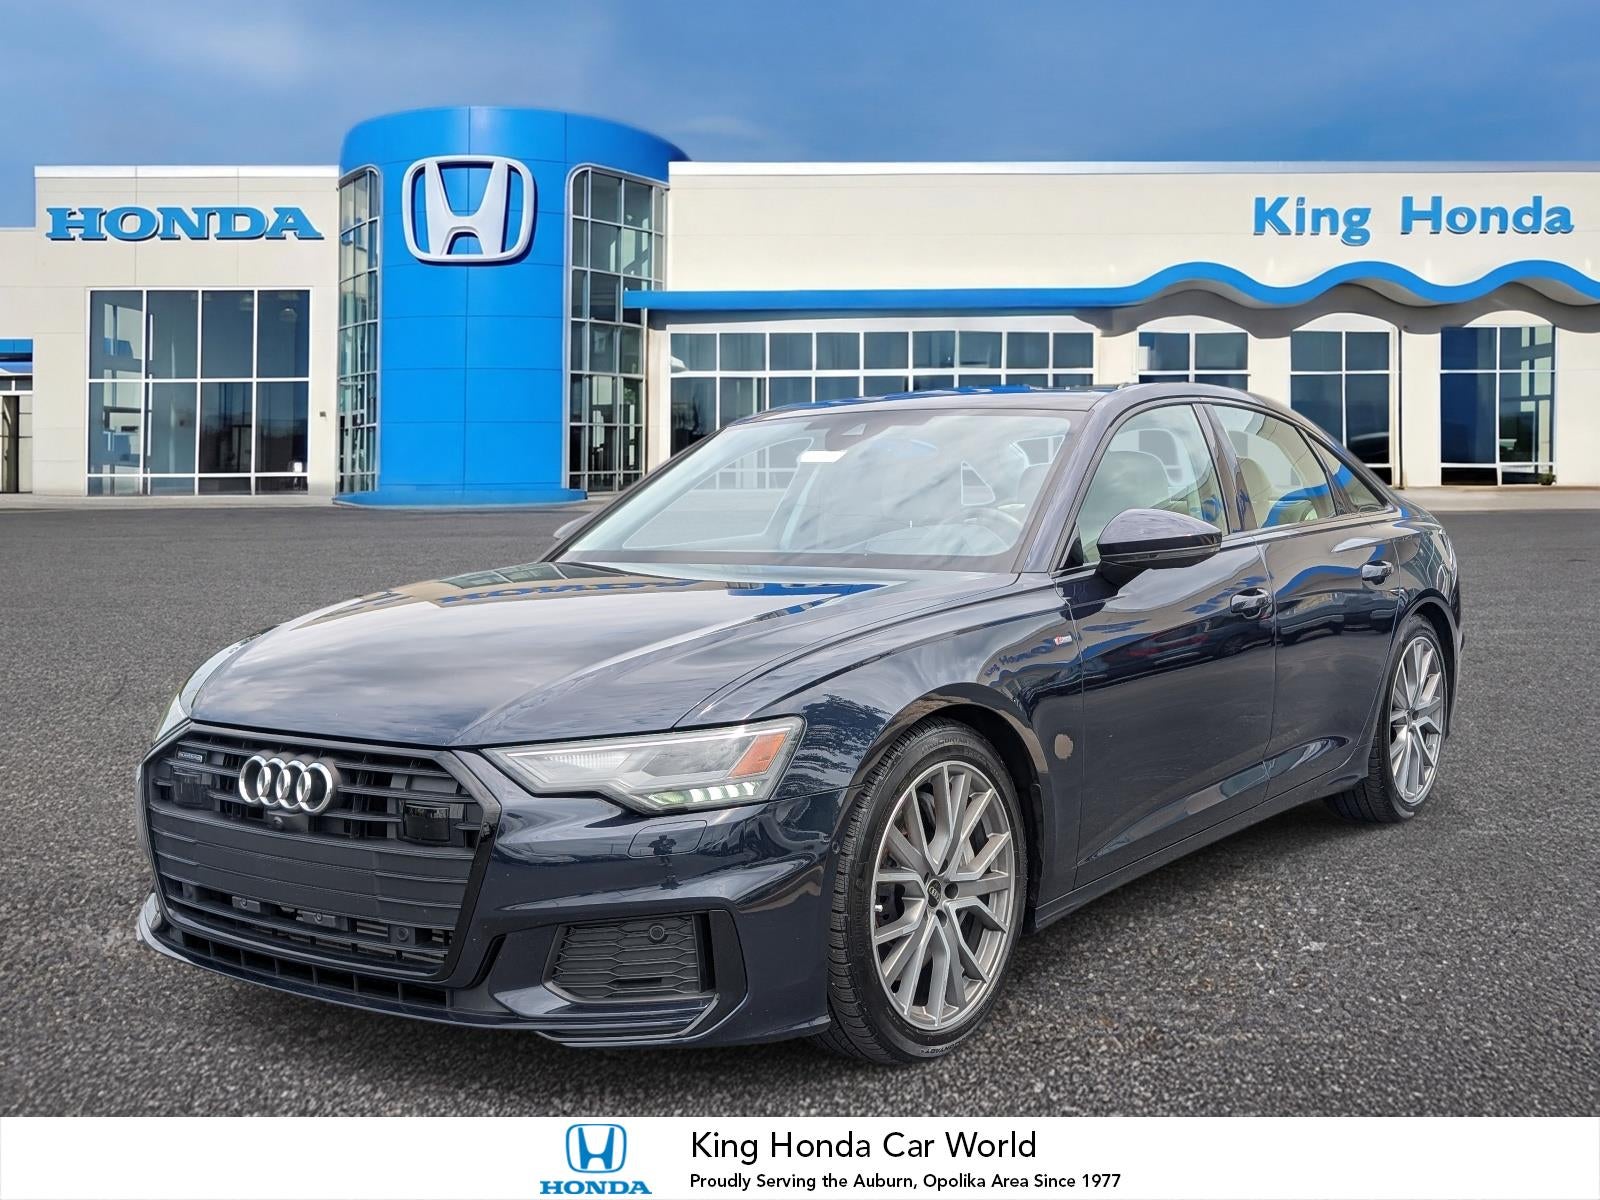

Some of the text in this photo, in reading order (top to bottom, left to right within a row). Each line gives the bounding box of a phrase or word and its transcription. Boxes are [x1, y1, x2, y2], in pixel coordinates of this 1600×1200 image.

[46, 206, 325, 241] HONDA
[1253, 195, 1575, 246] King Honda
